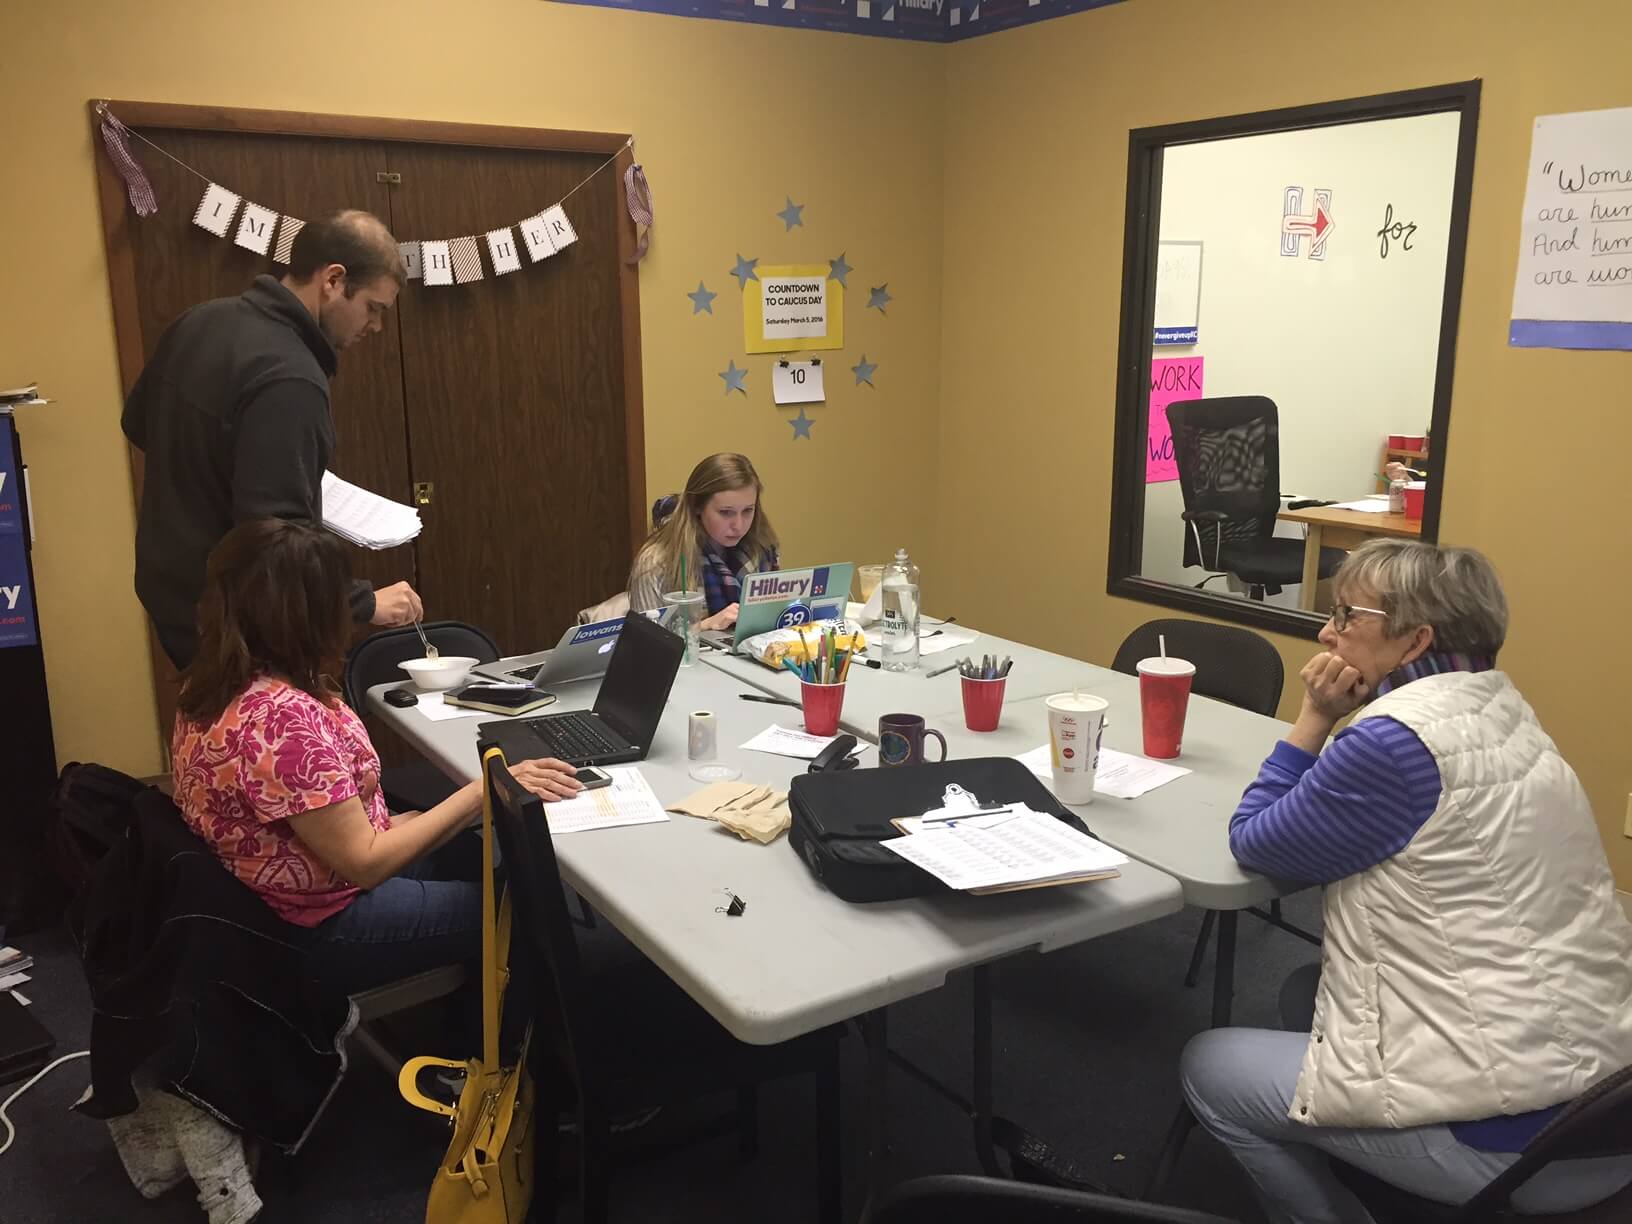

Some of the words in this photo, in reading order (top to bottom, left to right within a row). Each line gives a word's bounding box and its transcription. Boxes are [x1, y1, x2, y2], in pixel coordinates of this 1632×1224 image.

[1538, 206, 1579, 223] are
[496, 219, 566, 259] HER
[1377, 203, 1418, 260] for
[1532, 227, 1580, 256] And
[1534, 268, 1579, 285] are
[768, 284, 820, 294] COUNTDOWN
[765, 297, 777, 306] TO
[777, 296, 808, 306] CAUCUS
[808, 295, 823, 305] DAY
[766, 317, 790, 326] Saturday
[790, 316, 805, 324] March
[811, 315, 824, 323] 2016
[790, 368, 806, 384] 10
[1151, 365, 1201, 393] WORK
[1148, 434, 1176, 462] WO
[750, 577, 810, 598] Hillary
[783, 610, 805, 628] 39
[575, 623, 623, 641] Iowans
